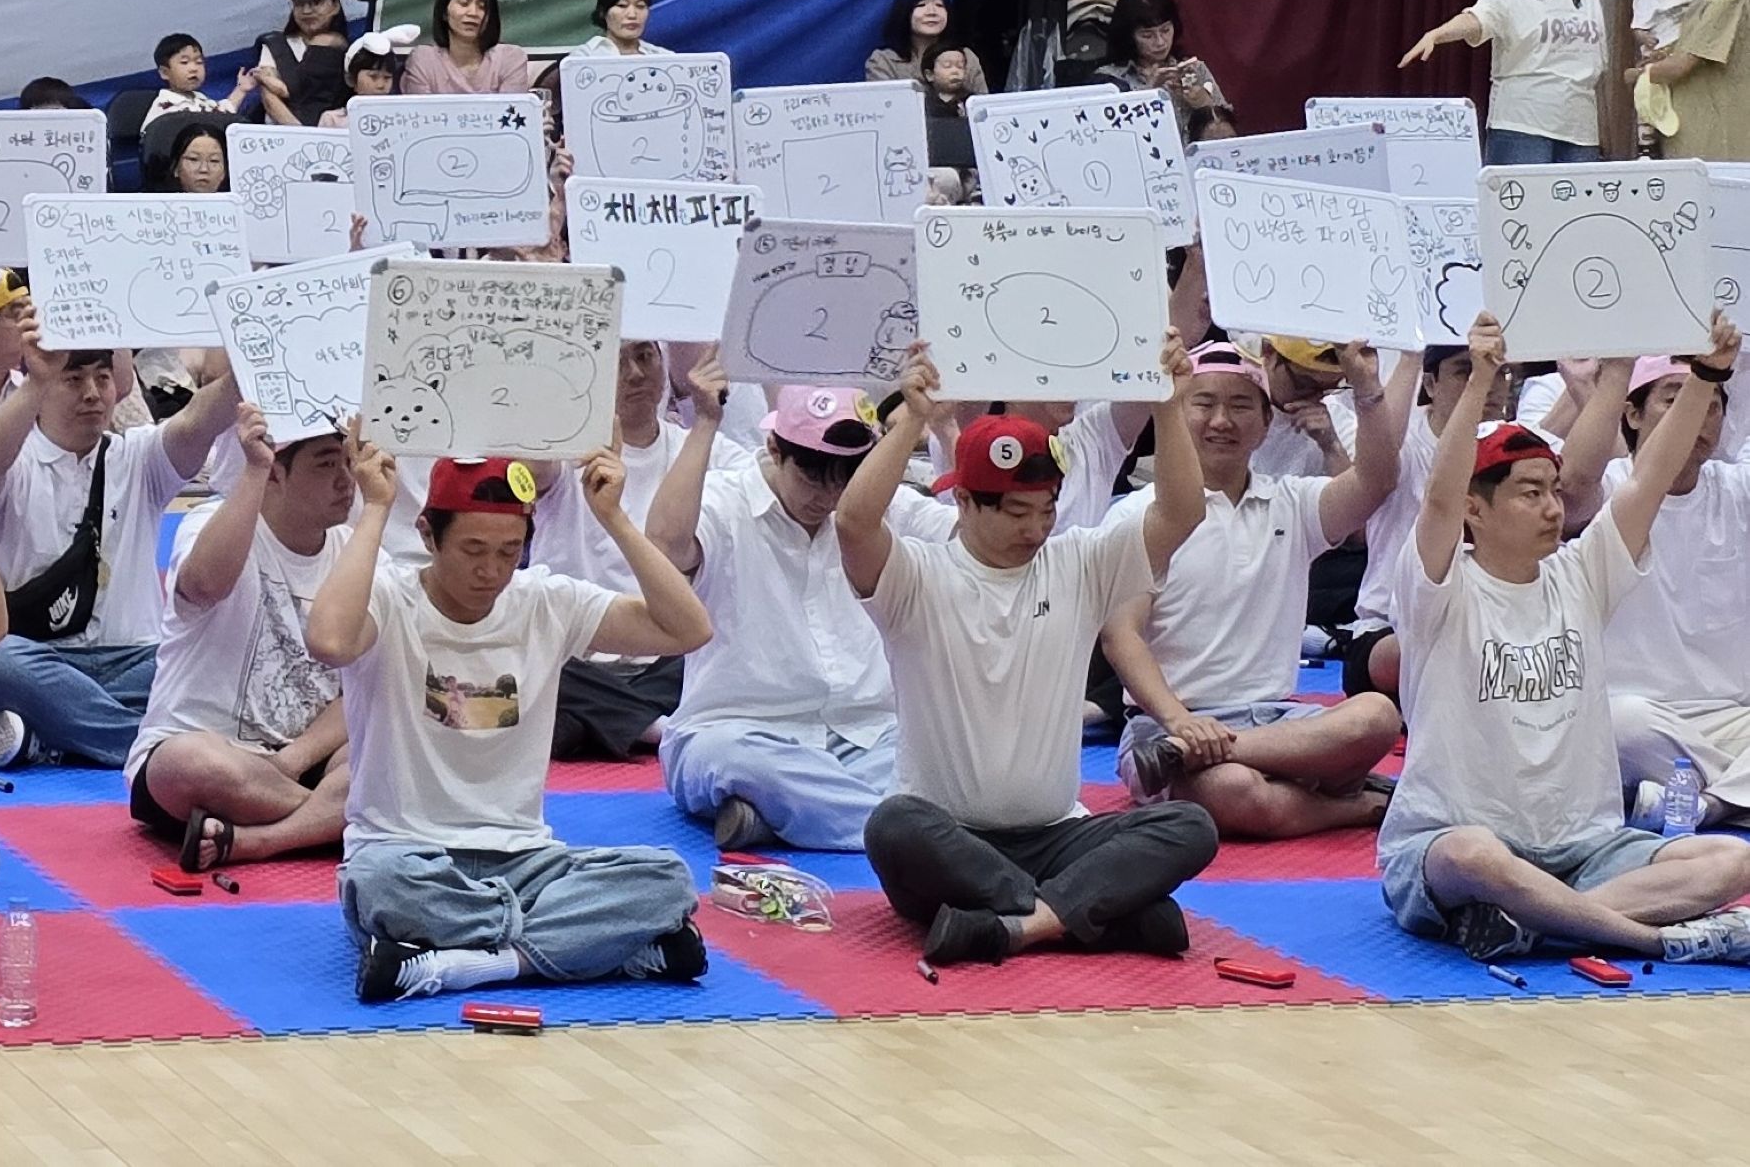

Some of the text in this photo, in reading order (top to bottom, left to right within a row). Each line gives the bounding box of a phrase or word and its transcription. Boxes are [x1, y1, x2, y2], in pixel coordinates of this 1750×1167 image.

[360, 116, 379, 133] 35
[630, 137, 661, 164] 2
[818, 174, 840, 195] 2
[1411, 164, 1428, 185] 2
[323, 210, 343, 232] 2
[149, 256, 194, 281] 정답
[647, 249, 696, 309] 2
[1301, 265, 1345, 313] 2
[176, 287, 208, 316] 2
[229, 290, 248, 310] 16
[805, 308, 828, 341] 2
[1040, 307, 1058, 326] 2
[814, 396, 831, 412] 15
[1000, 444, 1014, 461] 5
